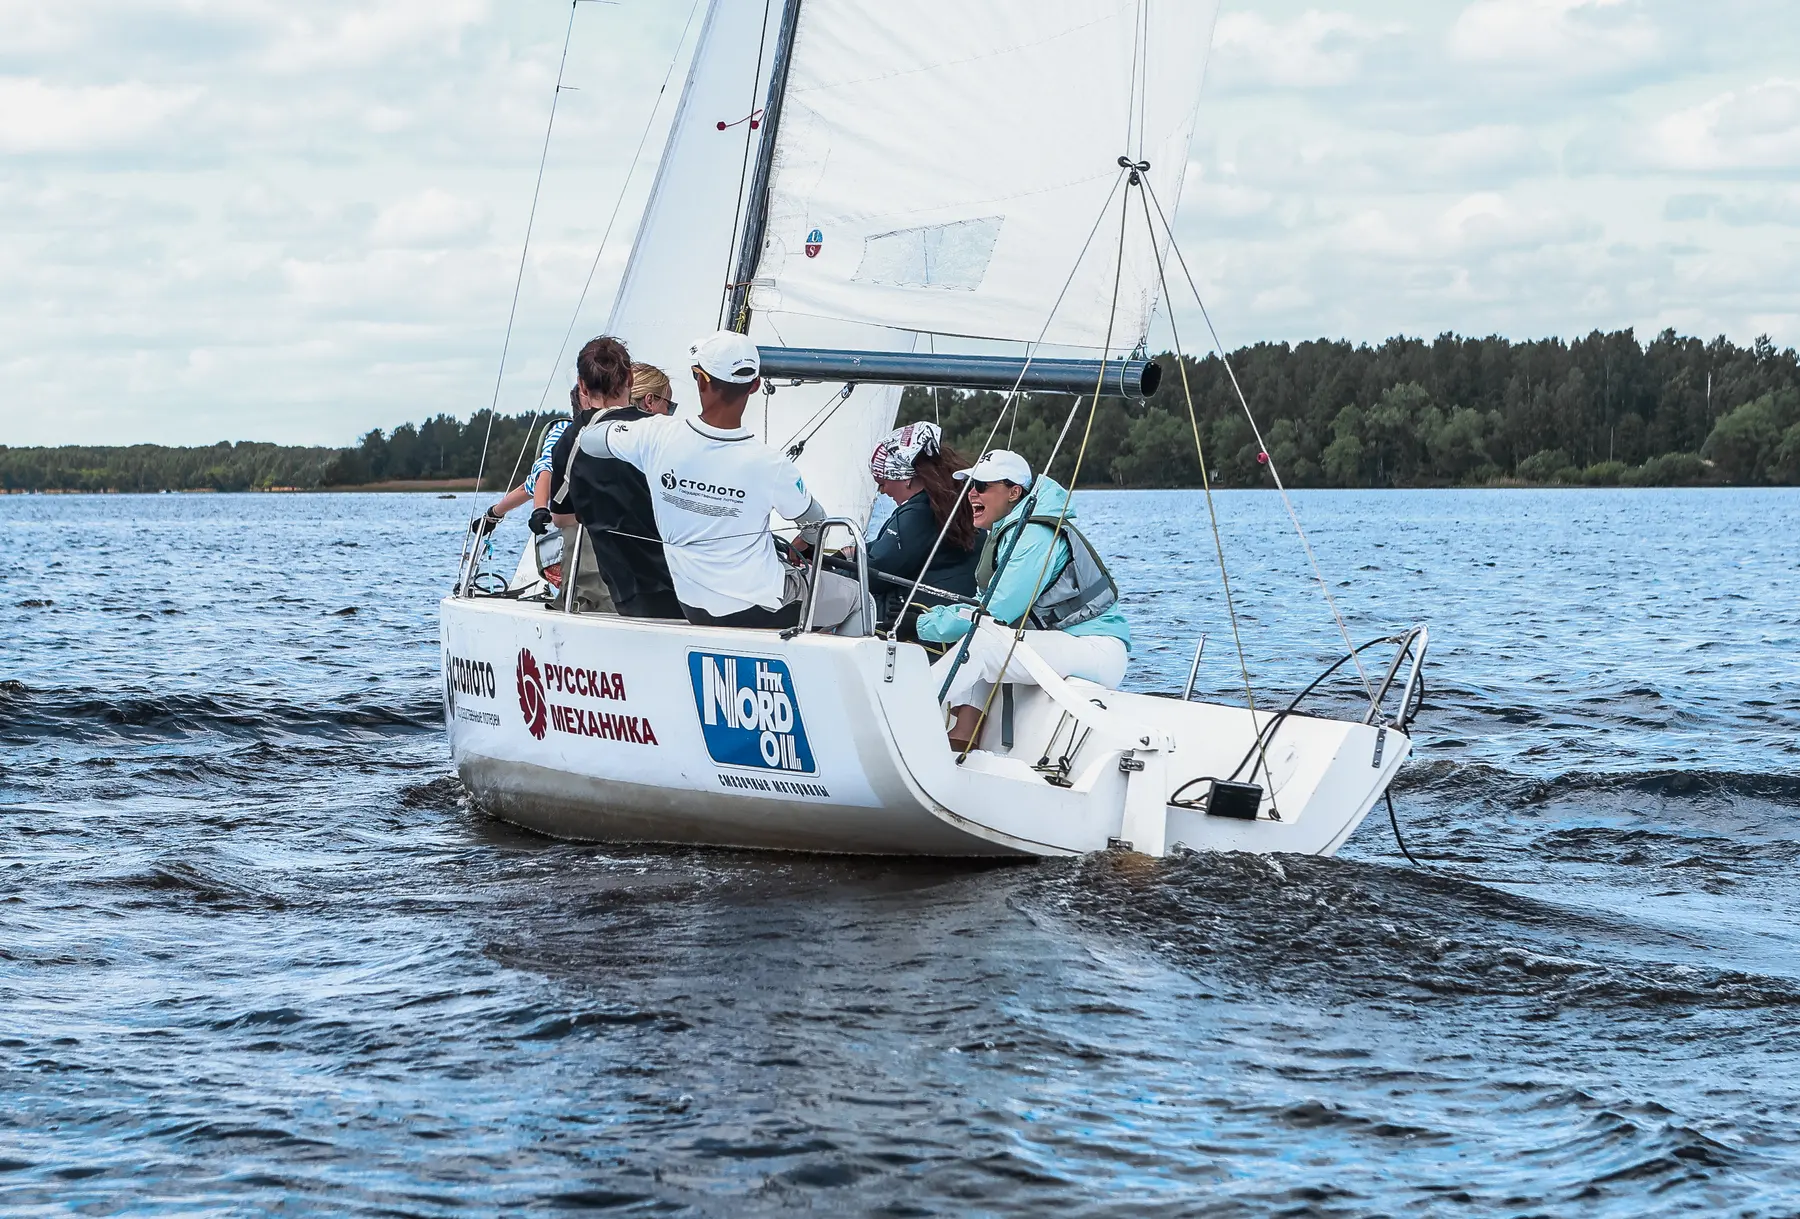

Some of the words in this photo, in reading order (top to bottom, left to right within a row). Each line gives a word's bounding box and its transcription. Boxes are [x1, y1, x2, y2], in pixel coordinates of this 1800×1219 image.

[679, 479, 746, 499] СТОЛОТО
[543, 662, 627, 701] РУССКАЯ
[549, 704, 659, 746] МЕХАНИКА
[759, 730, 803, 771] OIL
